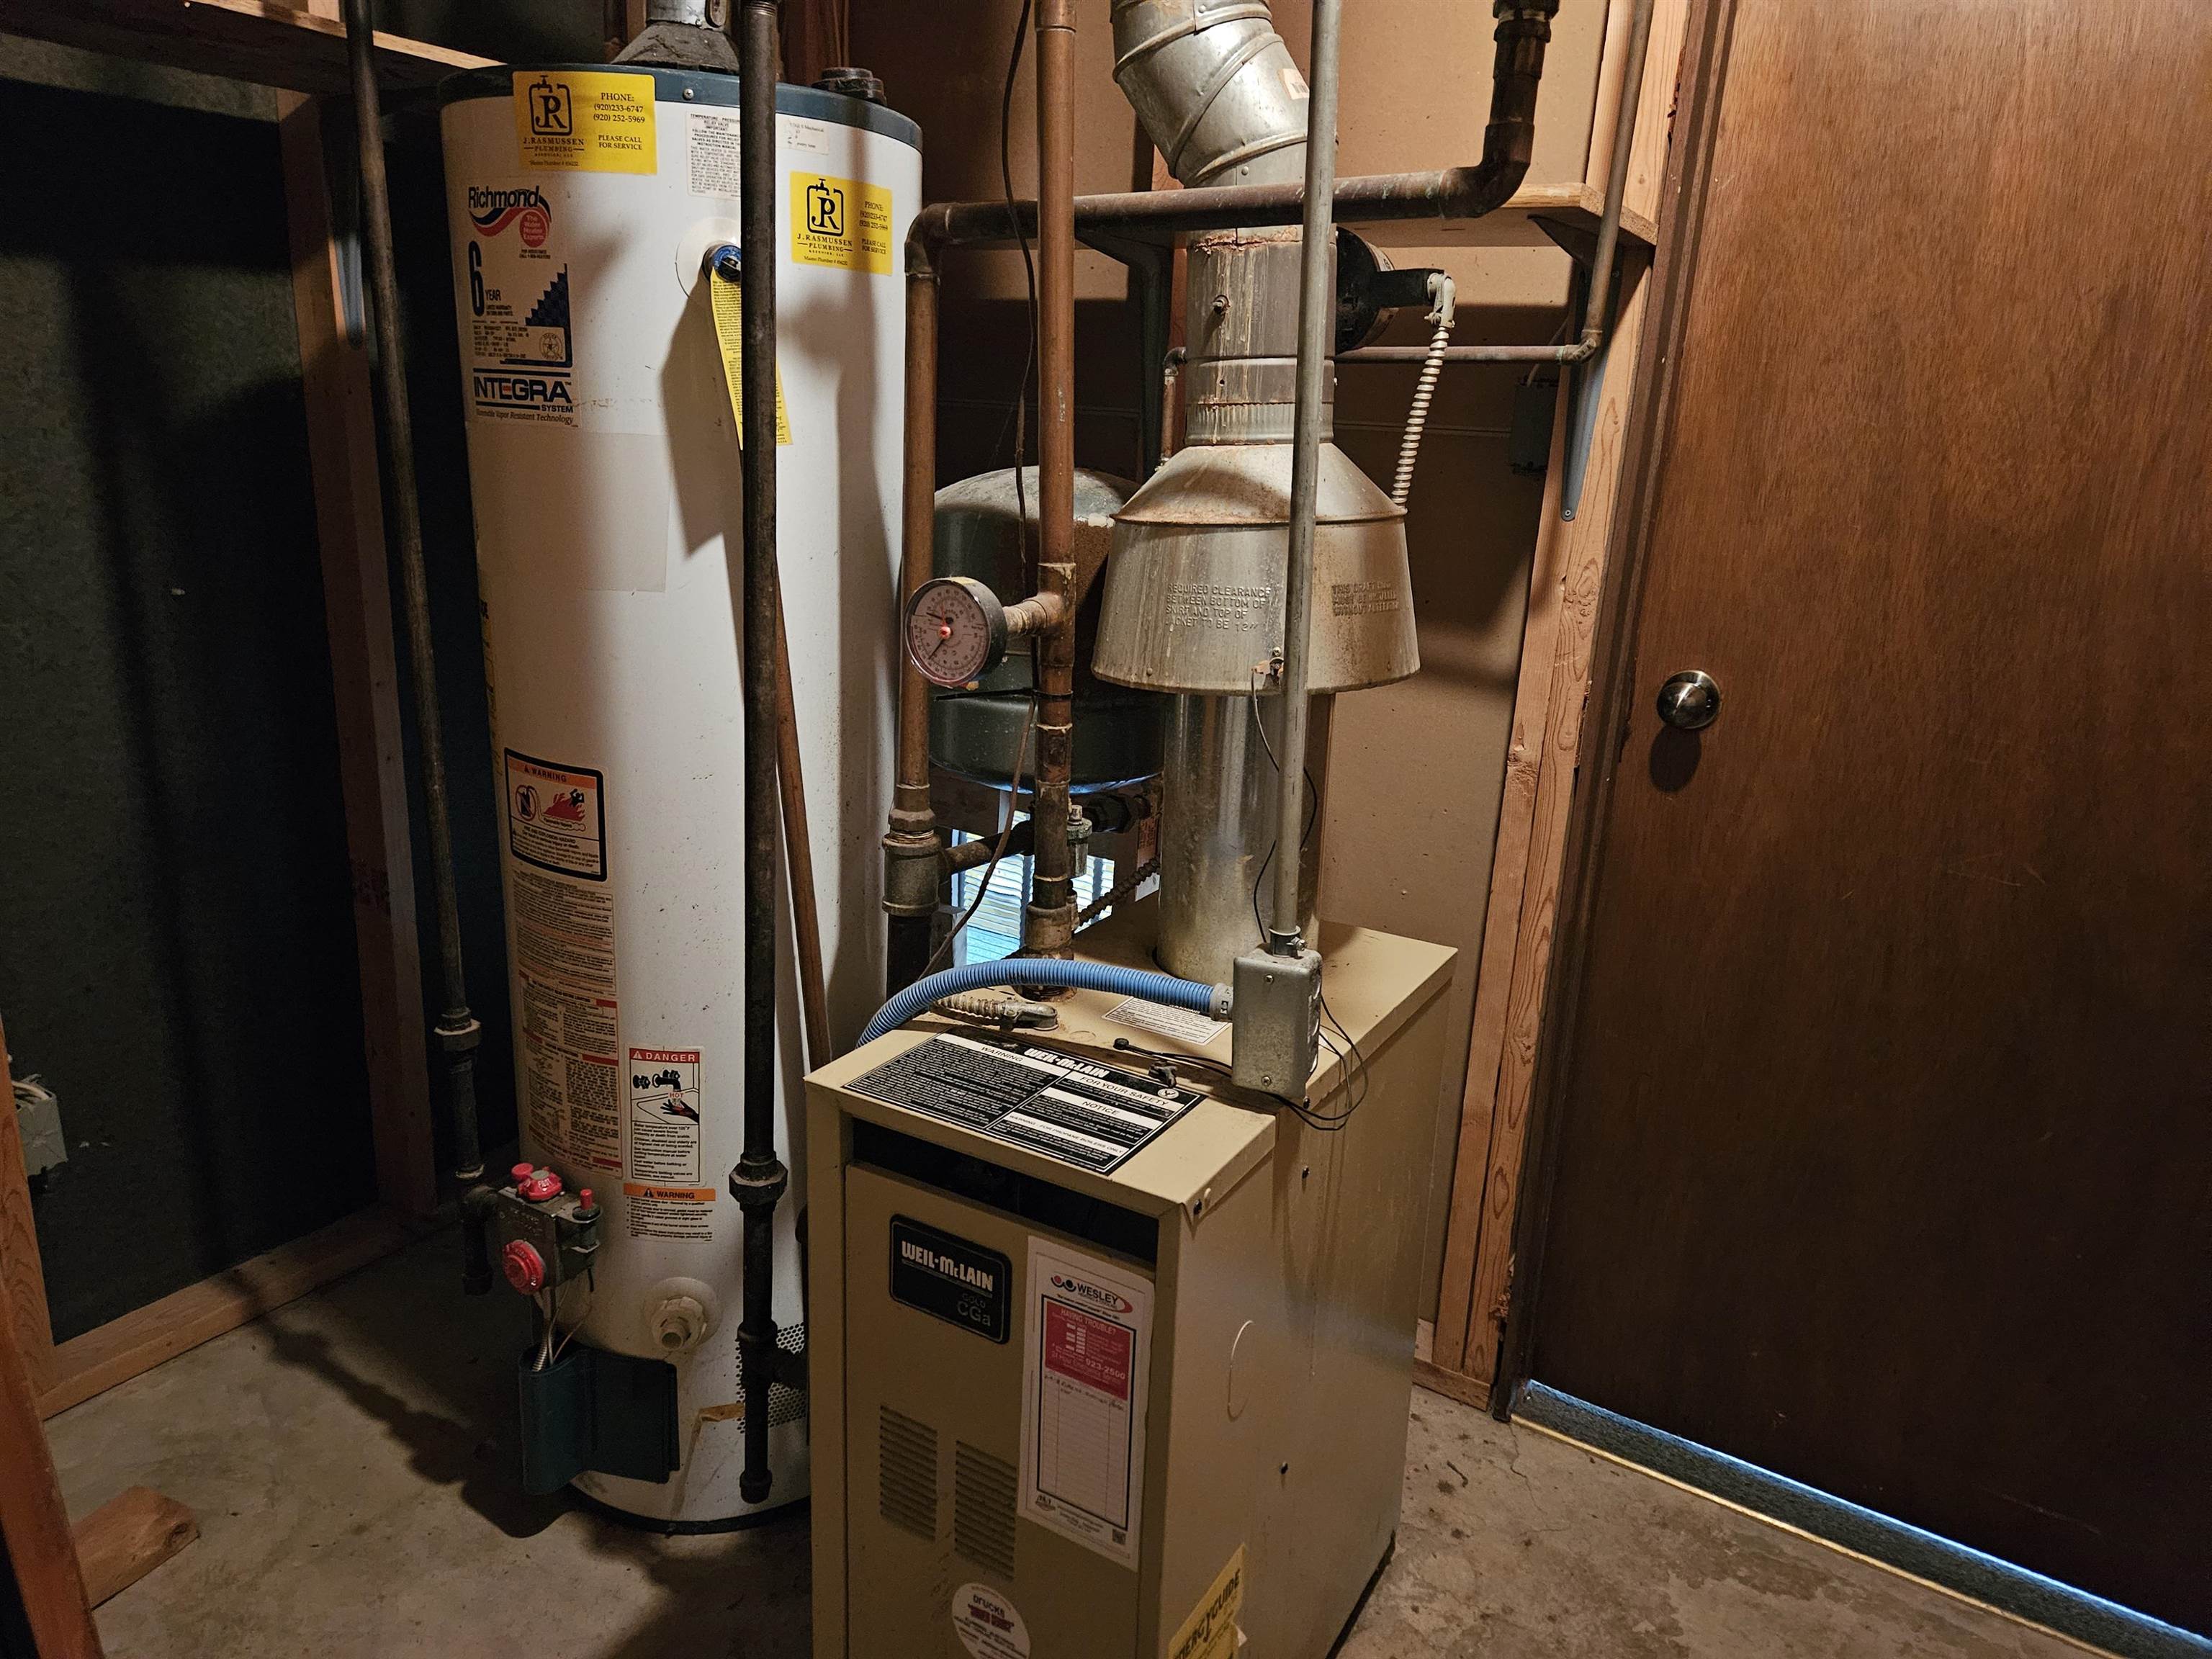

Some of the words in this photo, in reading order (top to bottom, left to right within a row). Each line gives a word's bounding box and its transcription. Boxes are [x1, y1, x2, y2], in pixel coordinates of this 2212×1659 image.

[601, 92, 634, 102] PHONE:
[593, 104, 644, 113] (920)233-6747
[468, 185, 539, 208] Richmond
[809, 243, 844, 252] PLUMBING
[469, 240, 485, 317] 6
[485, 289, 501, 301] YEAR
[510, 412, 535, 421] Resistant
[536, 413, 574, 426] Technology
[1168, 583, 1210, 594] REQUIRED
[1166, 594, 1207, 606] BETWEEN
[1210, 595, 1249, 608] BOTTOM
[1252, 598, 1267, 609] OF
[1213, 608, 1232, 618] TOP
[1235, 608, 1249, 619] OF
[1216, 619, 1230, 629] BE
[532, 768, 567, 782] WARNING
[646, 1052, 696, 1062] DANGER
[981, 1046, 1022, 1062] WARNING
[1080, 1076, 1101, 1087] FOR
[1103, 1082, 1129, 1095] YOUR
[1129, 1090, 1170, 1107] SAFETY
[1082, 1101, 1120, 1116] NOTICE
[657, 1190, 695, 1199] WARNING
[1077, 1282, 1118, 1305] WESLEY
[957, 1300, 992, 1326] CGa
